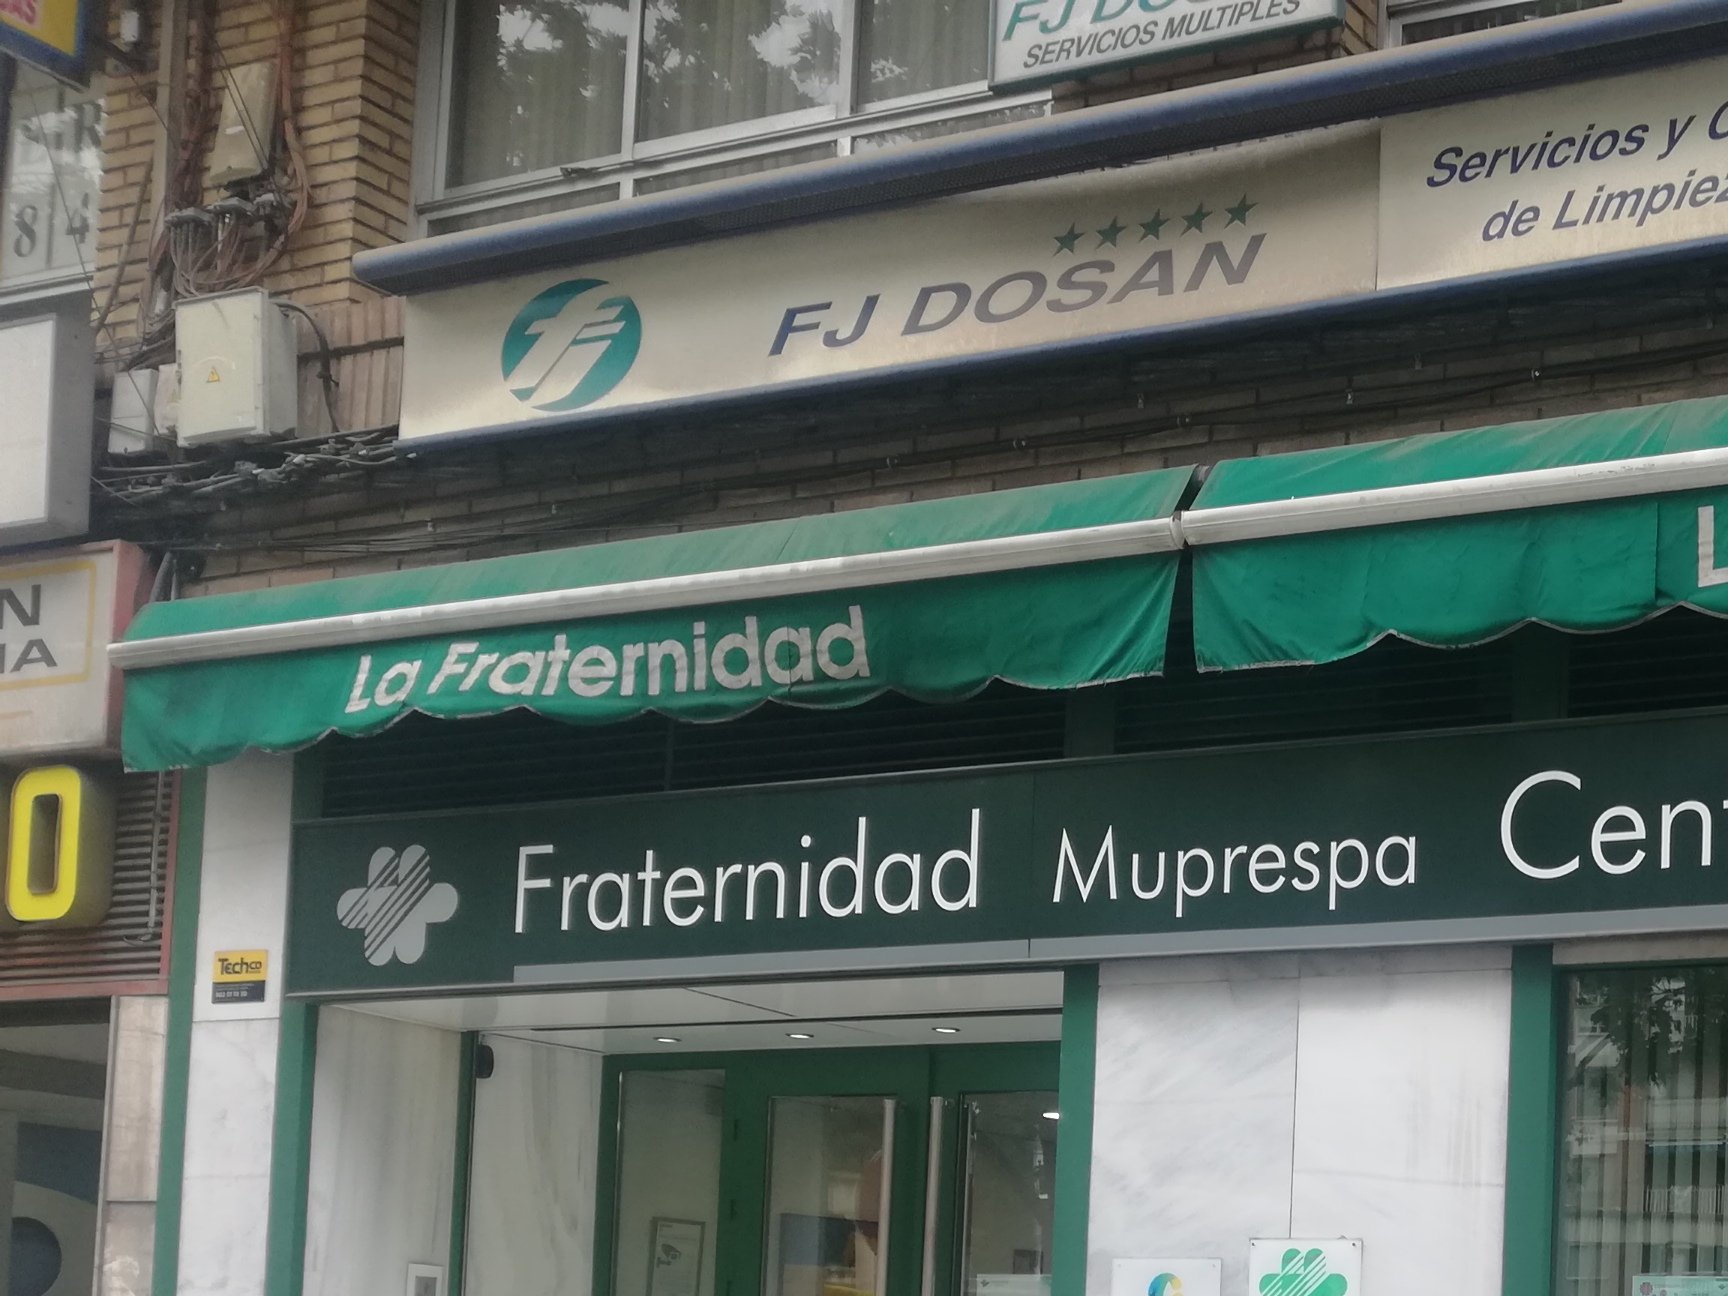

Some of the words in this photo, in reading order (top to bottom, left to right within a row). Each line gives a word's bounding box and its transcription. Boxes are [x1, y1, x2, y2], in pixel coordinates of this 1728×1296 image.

[1023, 20, 1158, 68] SERVICIOS
[1161, 0, 1300, 41] MULTIPLES
[1426, 117, 1645, 188] Servicios
[1657, 113, 1694, 158] y
[1482, 202, 1540, 242] de
[767, 294, 880, 357] FJ
[902, 234, 1267, 336] DOSAN
[345, 655, 422, 714] La
[427, 604, 871, 697] Fraternidad
[514, 808, 980, 934] Fraternidad
[1053, 825, 1417, 918] Muprespa
